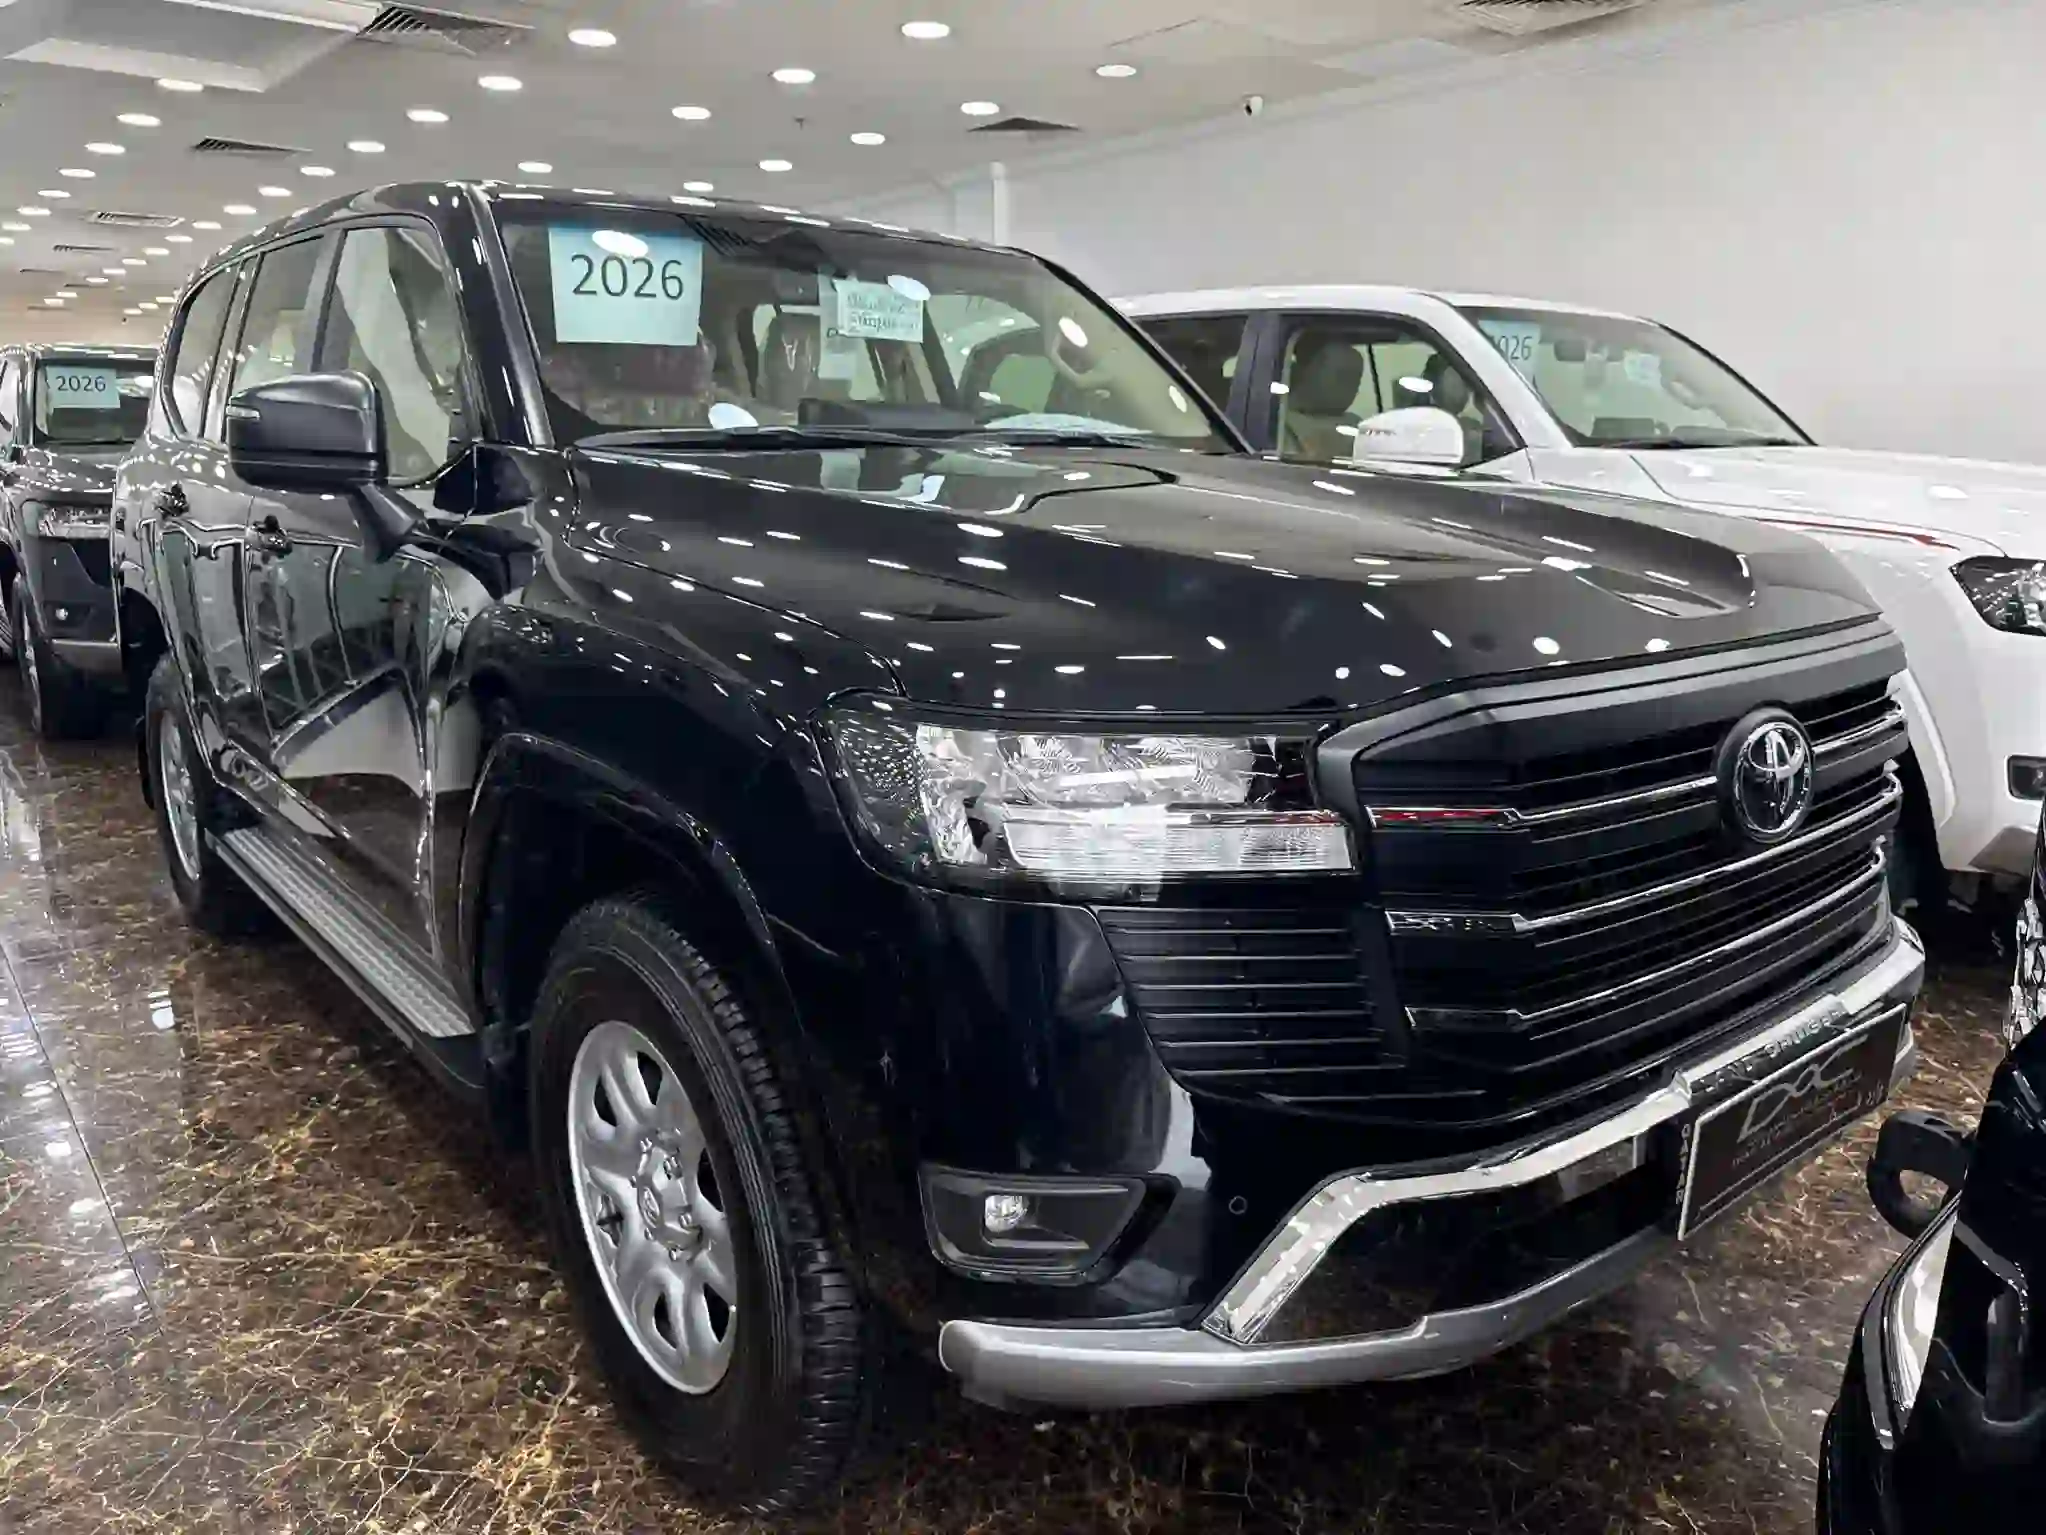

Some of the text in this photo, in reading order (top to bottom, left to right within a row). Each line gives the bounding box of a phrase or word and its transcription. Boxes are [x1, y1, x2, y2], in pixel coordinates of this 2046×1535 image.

[571, 254, 683, 300] 2026
[1491, 334, 1533, 361] 026
[55, 375, 106, 392] 2026
